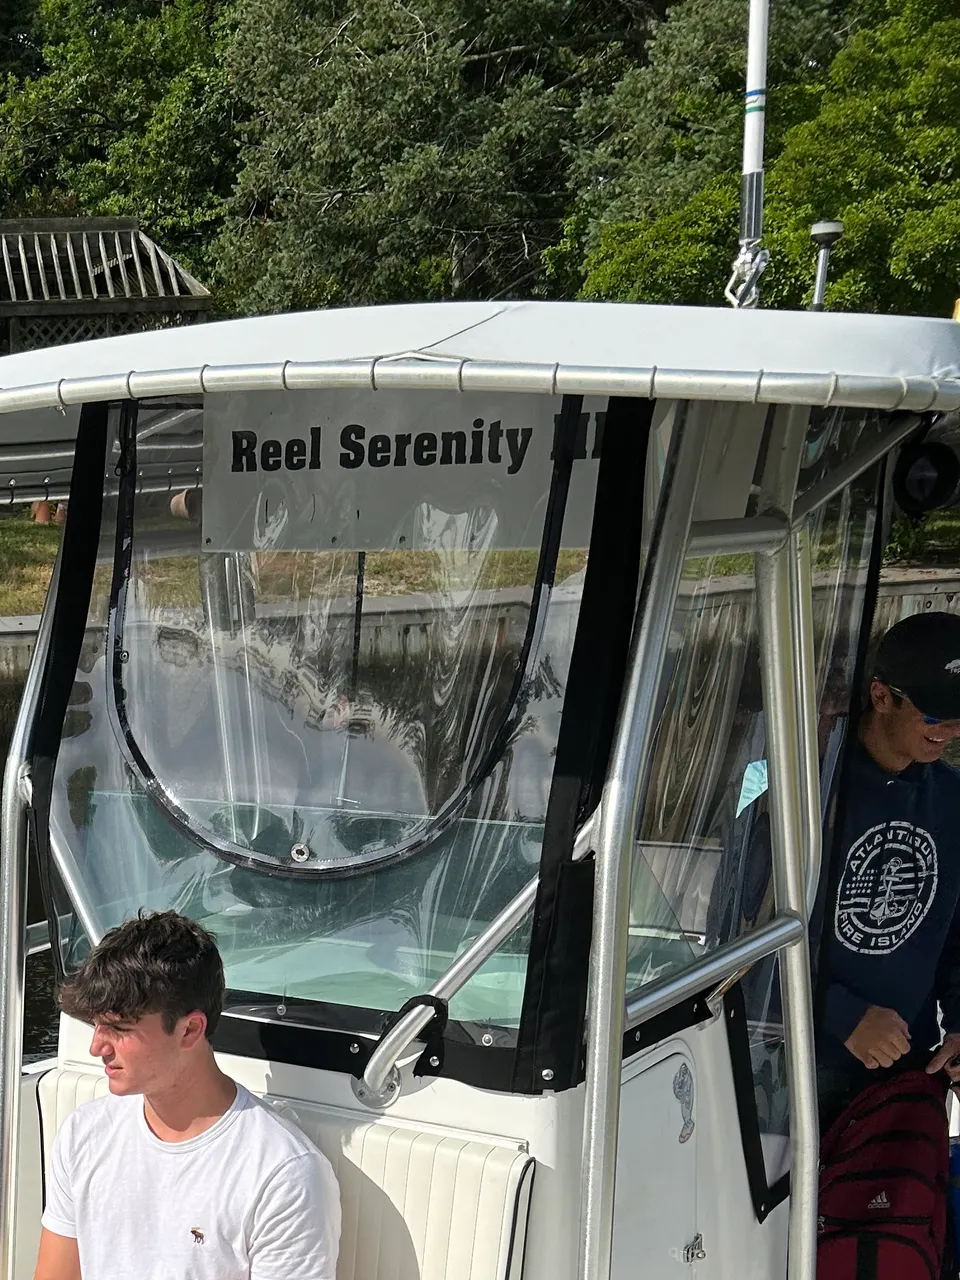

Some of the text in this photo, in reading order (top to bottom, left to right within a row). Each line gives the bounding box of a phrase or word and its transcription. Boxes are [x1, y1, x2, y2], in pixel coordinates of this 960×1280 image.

[232, 427, 321, 473] Reel
[339, 418, 534, 475] Serenity
[840, 912, 864, 944] FIRE
